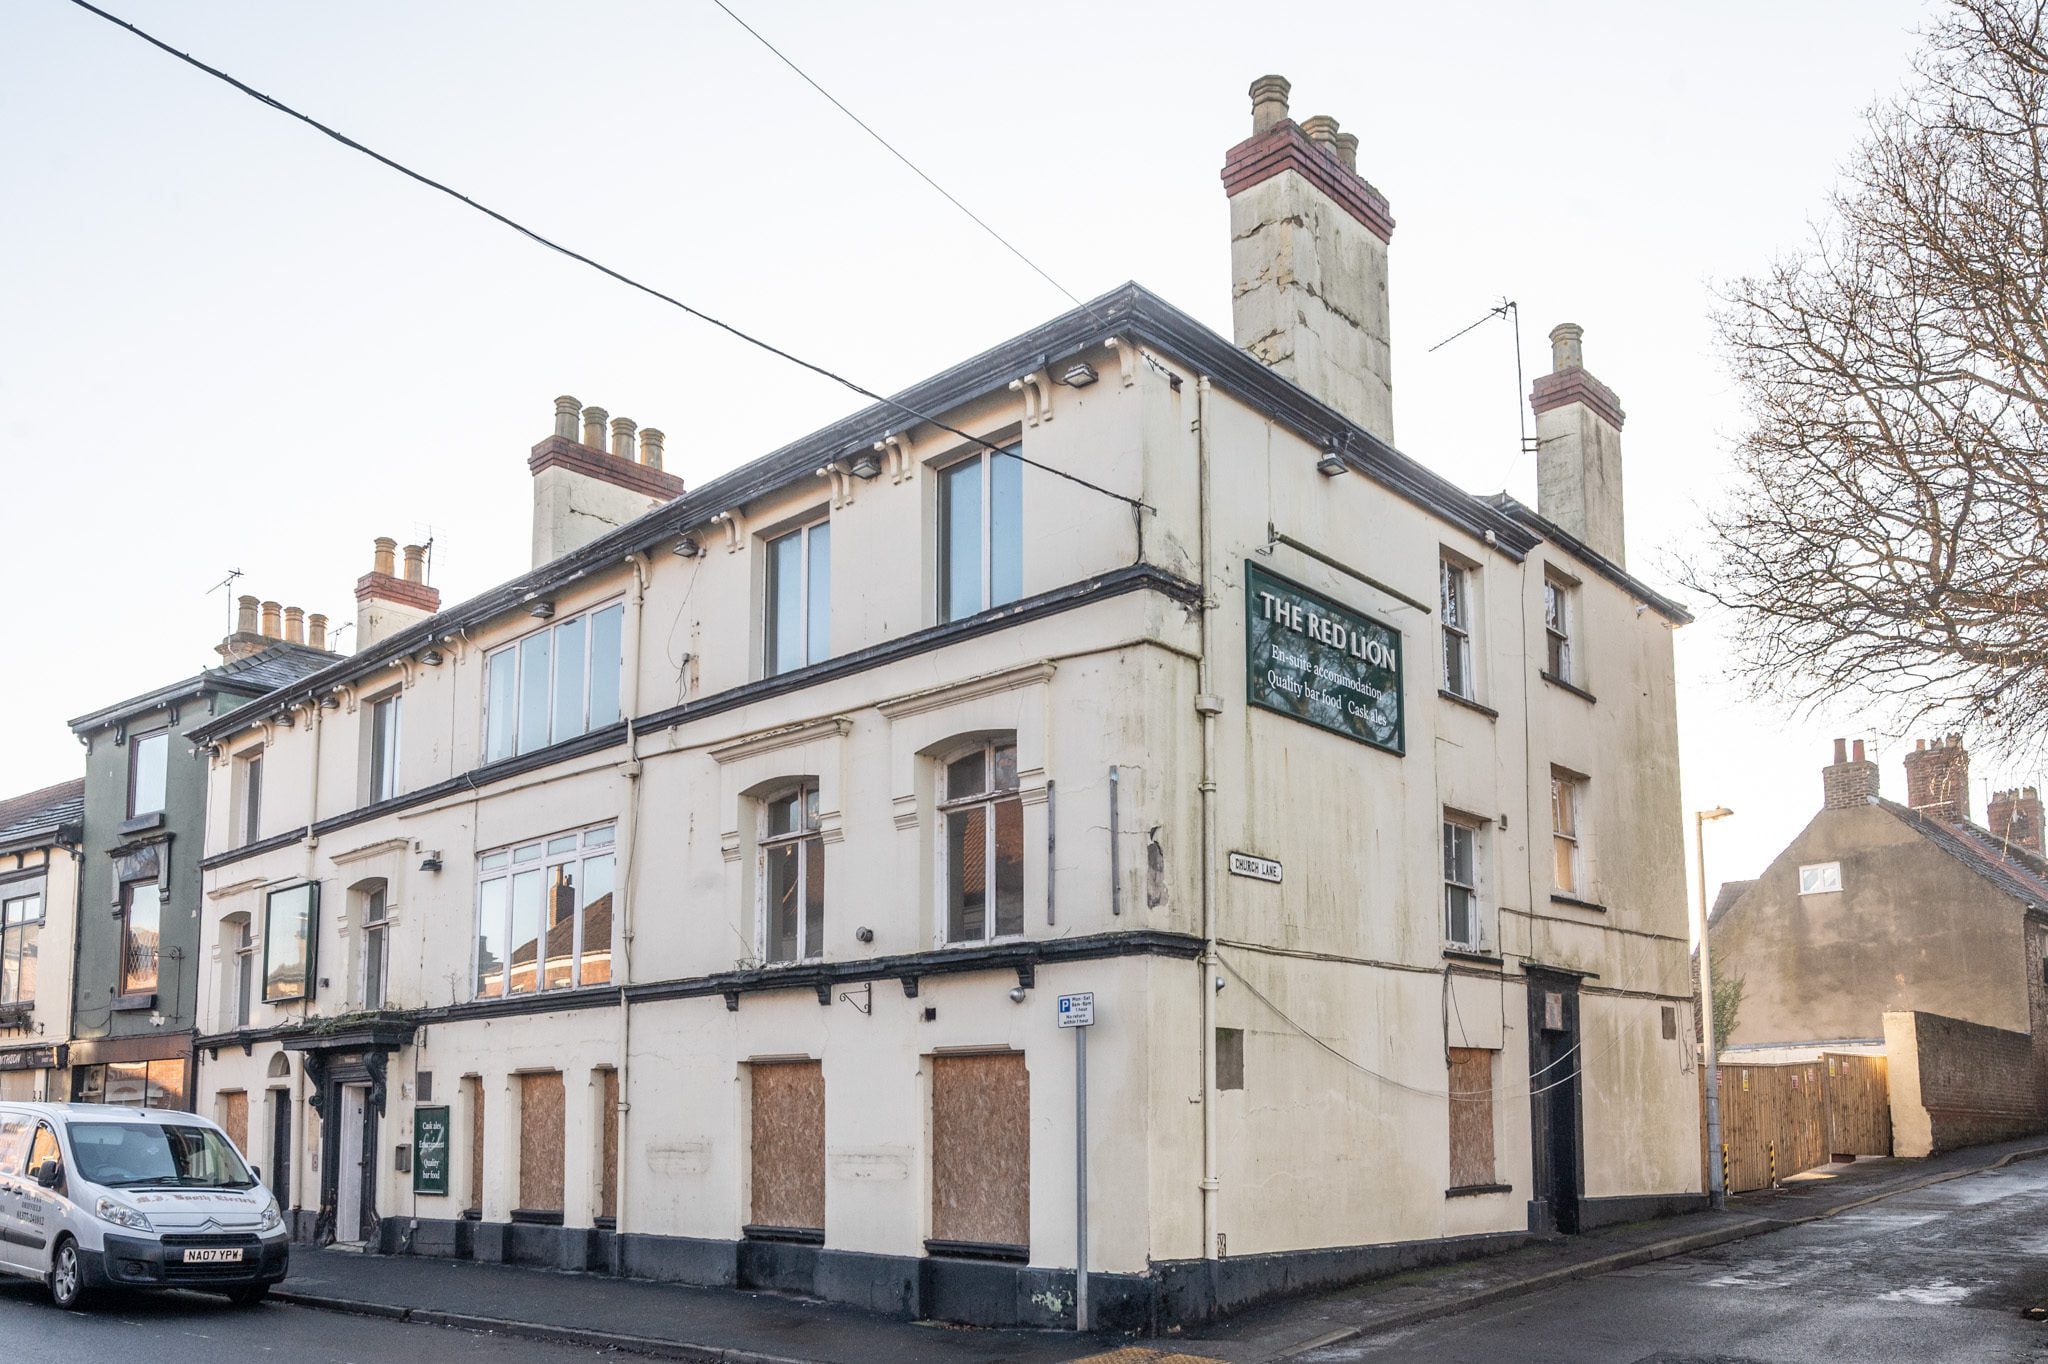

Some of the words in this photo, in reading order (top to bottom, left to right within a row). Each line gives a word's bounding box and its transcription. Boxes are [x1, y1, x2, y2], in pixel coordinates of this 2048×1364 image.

[1260, 592, 1303, 633] THE
[1308, 612, 1346, 650] RED
[1351, 632, 1396, 672] LION
[1271, 644, 1312, 673] En-suite
[1313, 663, 1382, 700] accommodation
[1267, 670, 1303, 698] Quality
[1304, 684, 1320, 702] bar
[1322, 689, 1342, 710] food
[1348, 700, 1369, 720] Cask
[1370, 708, 1387, 726] ales
[1235, 858, 1260, 874] CHURCH
[1261, 863, 1280, 878] LANE
[423, 1121, 432, 1130] Cask
[424, 1159, 440, 1168] Quality
[430, 1170, 440, 1179] food
[189, 1250, 217, 1261] NA07
[219, 1250, 239, 1260] YPW
